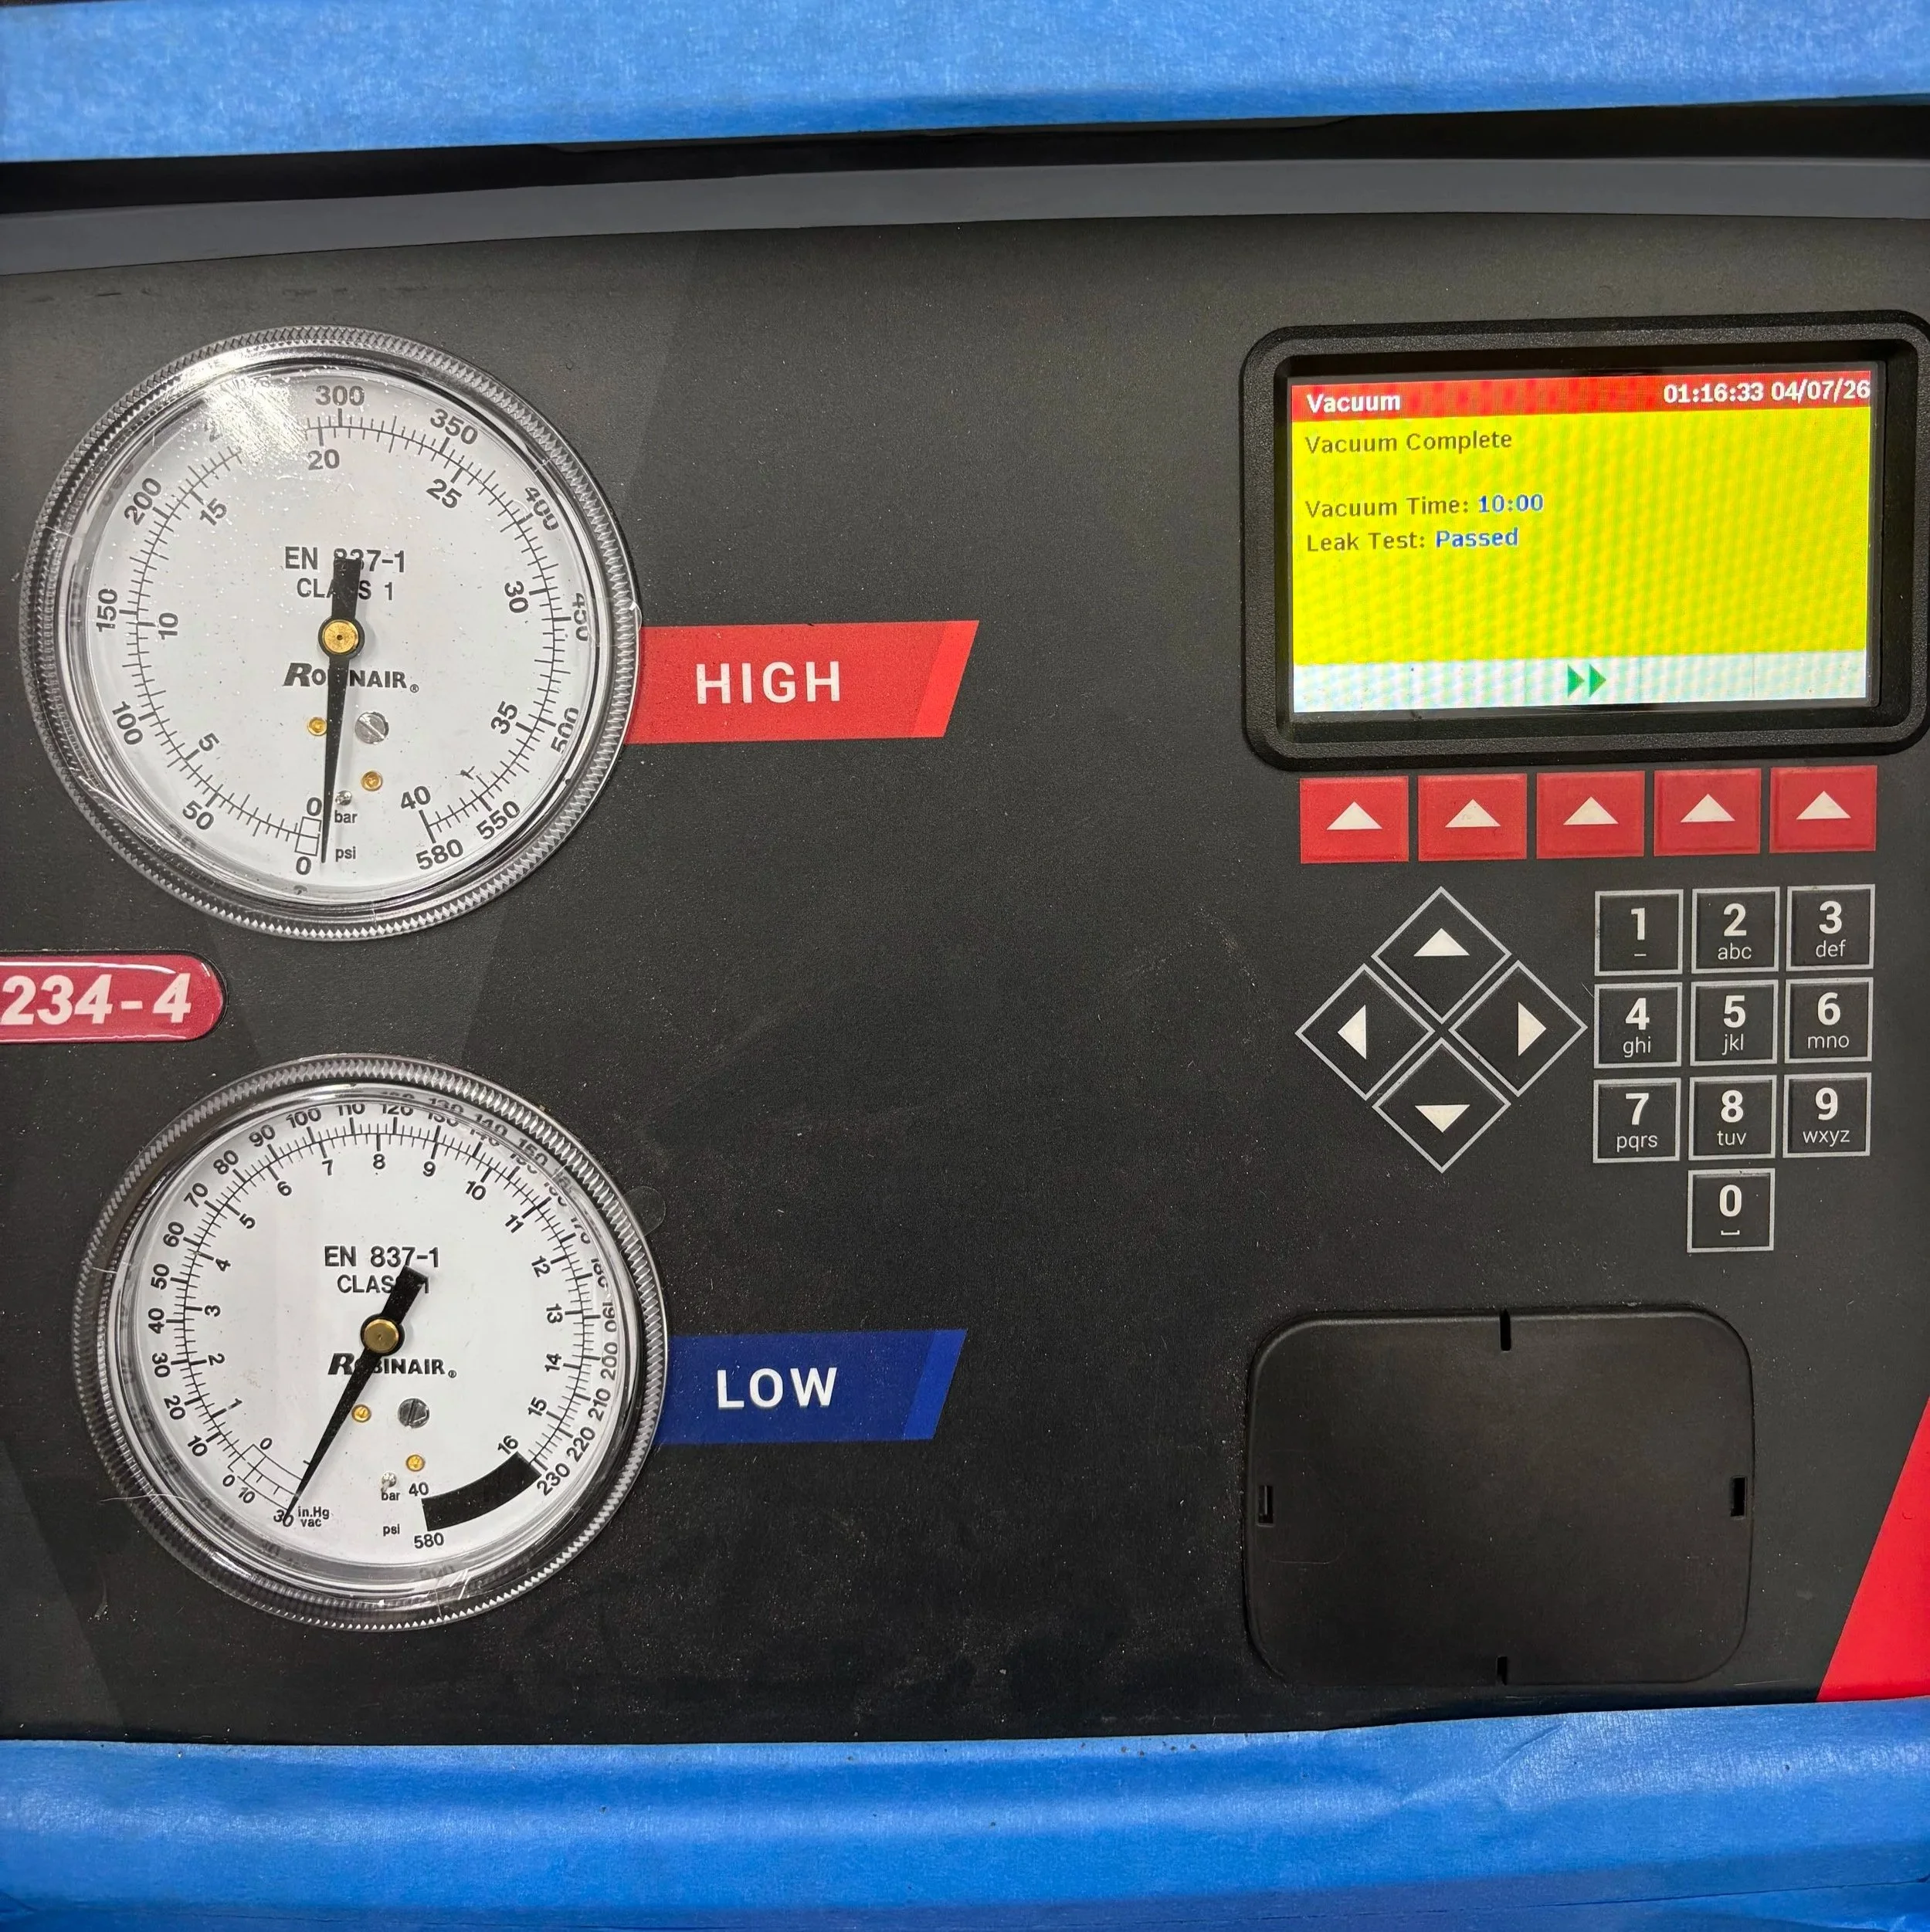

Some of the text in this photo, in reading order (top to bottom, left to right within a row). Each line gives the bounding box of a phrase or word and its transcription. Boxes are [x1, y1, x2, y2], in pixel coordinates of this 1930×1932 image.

[315, 385, 365, 407] 300
[1663, 378, 1871, 404] 01:16:33 04/07/26
[1307, 394, 1401, 413] Vacuum
[430, 408, 478, 446] 350
[1304, 430, 1512, 454] Vacuum Complete
[308, 449, 340, 470] 20
[124, 477, 162, 526] 200
[426, 478, 463, 510] 25
[199, 497, 228, 527] 15
[525, 487, 560, 531] 400
[1304, 493, 1544, 519] Vacuum Time: 10:00
[1307, 527, 1519, 552] Leak Test: Passed
[285, 546, 318, 570] EN
[384, 581, 392, 601] 1
[504, 581, 530, 614] 30
[96, 588, 118, 632] 150
[572, 592, 589, 642] 450
[158, 612, 179, 640] 10
[696, 661, 840, 704] HIGH
[112, 700, 144, 745] 100
[490, 700, 519, 734] 35
[550, 707, 580, 754] 500
[198, 733, 220, 752] 5
[306, 797, 323, 817] 0
[400, 785, 431, 810] 40
[182, 800, 215, 830] 50
[334, 810, 358, 825] bar
[475, 800, 521, 840] 550
[335, 845, 357, 863] psi
[416, 839, 465, 870] 580
[295, 856, 312, 876] 0
[1630, 907, 1647, 941] 1
[1723, 903, 1747, 937] 2
[1818, 900, 1843, 934] 3
[1717, 941, 1752, 961] abc
[1815, 940, 1847, 958] def
[0, 973, 192, 1025] 234-4
[1816, 992, 1841, 1025] 6
[1625, 997, 1650, 1031] 4
[1723, 995, 1746, 1029] 5
[1623, 1036, 1651, 1058] ghi
[1721, 1033, 1744, 1056] jkl
[1806, 1034, 1850, 1049] mno
[337, 1103, 366, 1117] 110
[382, 1103, 414, 1117] 120
[1625, 1092, 1650, 1126] 7
[1720, 1090, 1744, 1123] 8
[1815, 1087, 1839, 1120] 9
[285, 1107, 322, 1129] 100
[249, 1124, 276, 1147] 90
[1616, 1132, 1658, 1153] pqrs
[1717, 1130, 1747, 1146] tuv
[1802, 1129, 1850, 1150] wxyz
[212, 1150, 240, 1175] 80
[321, 1160, 334, 1176] 7
[372, 1153, 387, 1170] 8
[422, 1161, 436, 1177] 9
[183, 1182, 209, 1208] 70
[277, 1181, 293, 1197] 6
[465, 1181, 487, 1201] 10
[1718, 1185, 1742, 1217] 0
[239, 1213, 256, 1229] 5
[504, 1214, 524, 1233] 11
[163, 1222, 185, 1248] 60
[215, 1259, 232, 1273] 4
[324, 1246, 439, 1268] EN 837-1
[531, 1255, 551, 1278] 12
[151, 1263, 170, 1290] 50
[337, 1274, 397, 1294] CLAS
[148, 1307, 165, 1334] 40
[204, 1305, 222, 1317] 3
[546, 1303, 564, 1324] 13
[602, 1301, 618, 1333] 190
[151, 1353, 171, 1378] 30
[208, 1353, 226, 1365] 2
[544, 1353, 563, 1373] 14
[600, 1342, 618, 1381] 200
[717, 1367, 837, 1408] LOW
[163, 1395, 186, 1420] 20
[228, 1398, 243, 1411] 1
[527, 1396, 548, 1418] 15
[587, 1388, 612, 1422] 210
[187, 1435, 209, 1457] 10
[259, 1437, 273, 1451] 0
[497, 1435, 520, 1456] 16
[566, 1427, 596, 1463] 220
[222, 1474, 236, 1487] 0
[409, 1482, 429, 1497] 40
[537, 1463, 571, 1496] 230
[238, 1486, 256, 1504] 10
[381, 1487, 401, 1501] bar
[273, 1509, 295, 1527] 30
[297, 1506, 331, 1520] in.Hg
[300, 1519, 323, 1528] vac
[382, 1524, 400, 1537] psi
[413, 1532, 446, 1550] 580
